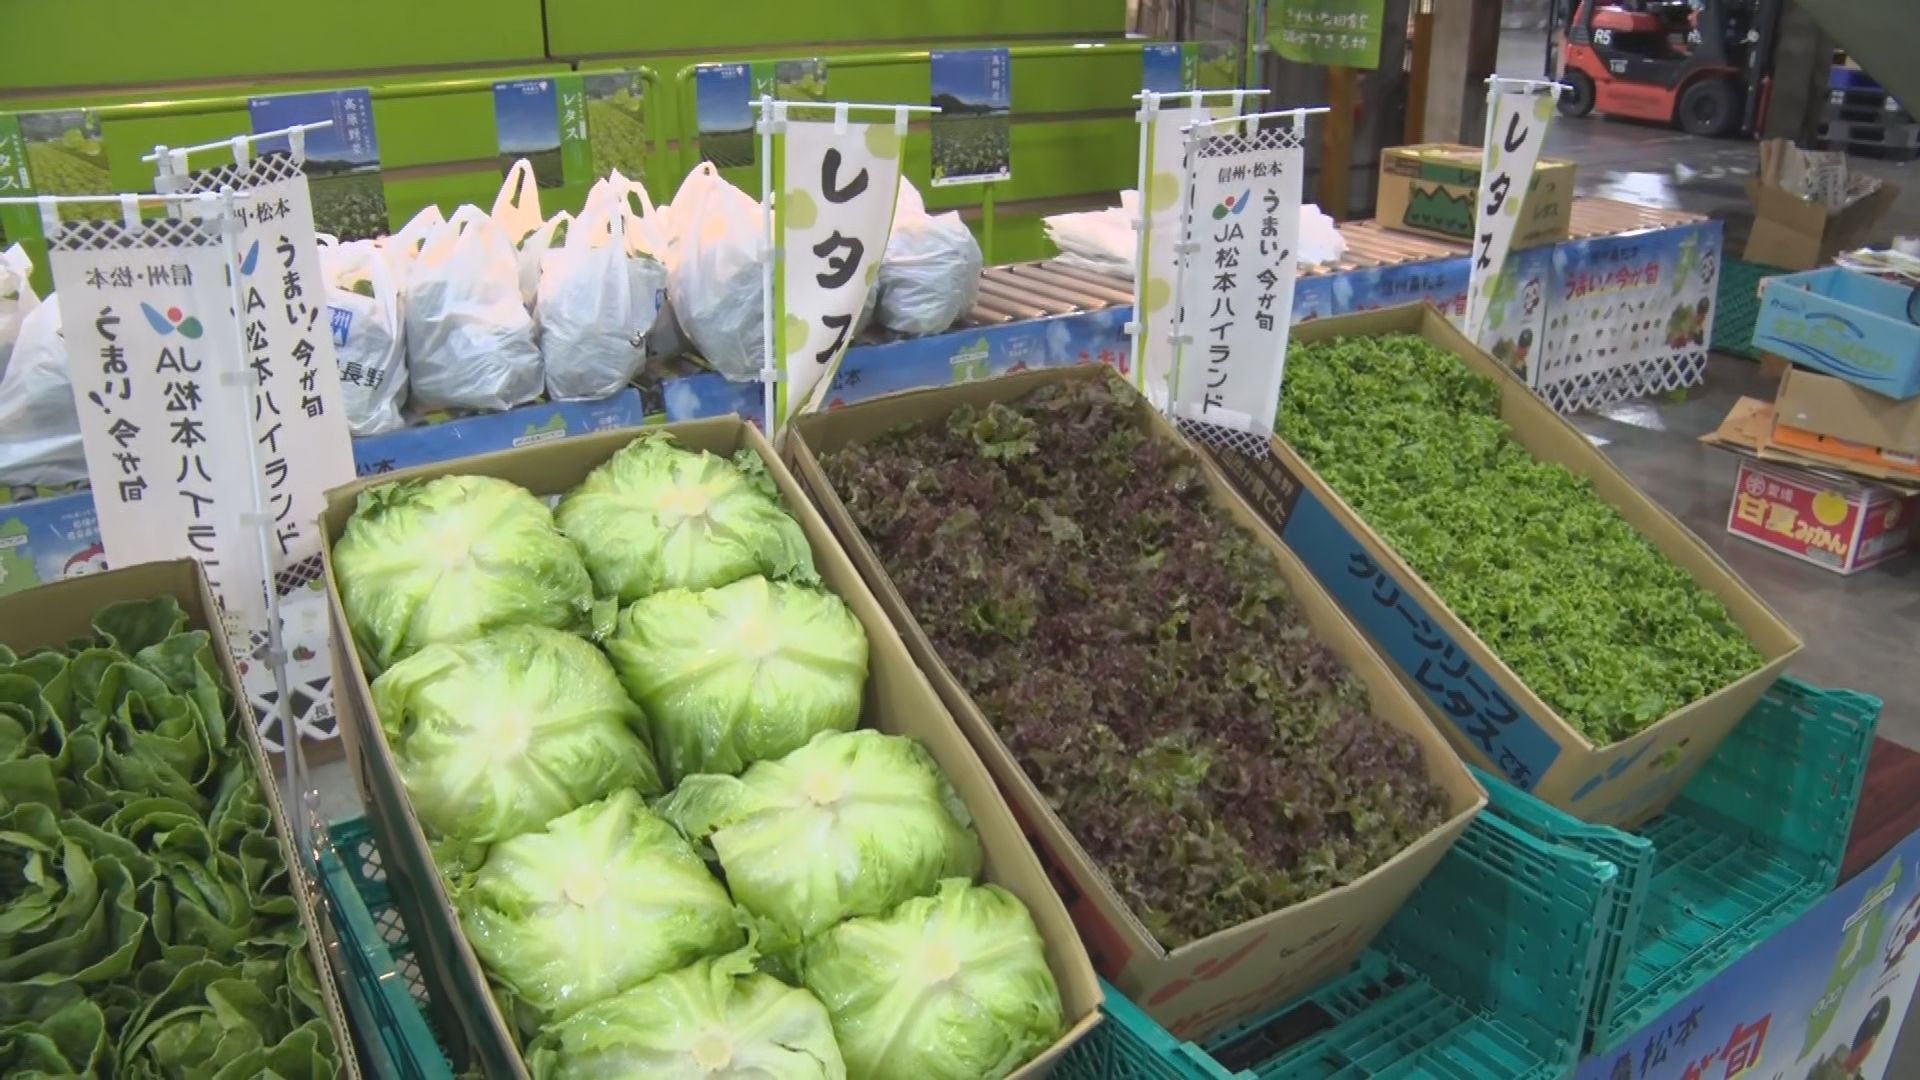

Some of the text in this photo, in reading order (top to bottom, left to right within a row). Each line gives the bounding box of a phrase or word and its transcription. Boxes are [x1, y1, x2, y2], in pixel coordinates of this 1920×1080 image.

[563, 93, 579, 140] レタス
[1594, 29, 1612, 45] R5
[1217, 161, 1284, 184] 信州・松本
[1476, 111, 1528, 271] レタス
[813, 147, 869, 365] レタス
[1203, 222, 1245, 415] JA松本ハイランド
[246, 286, 300, 555] A松本ハイランド
